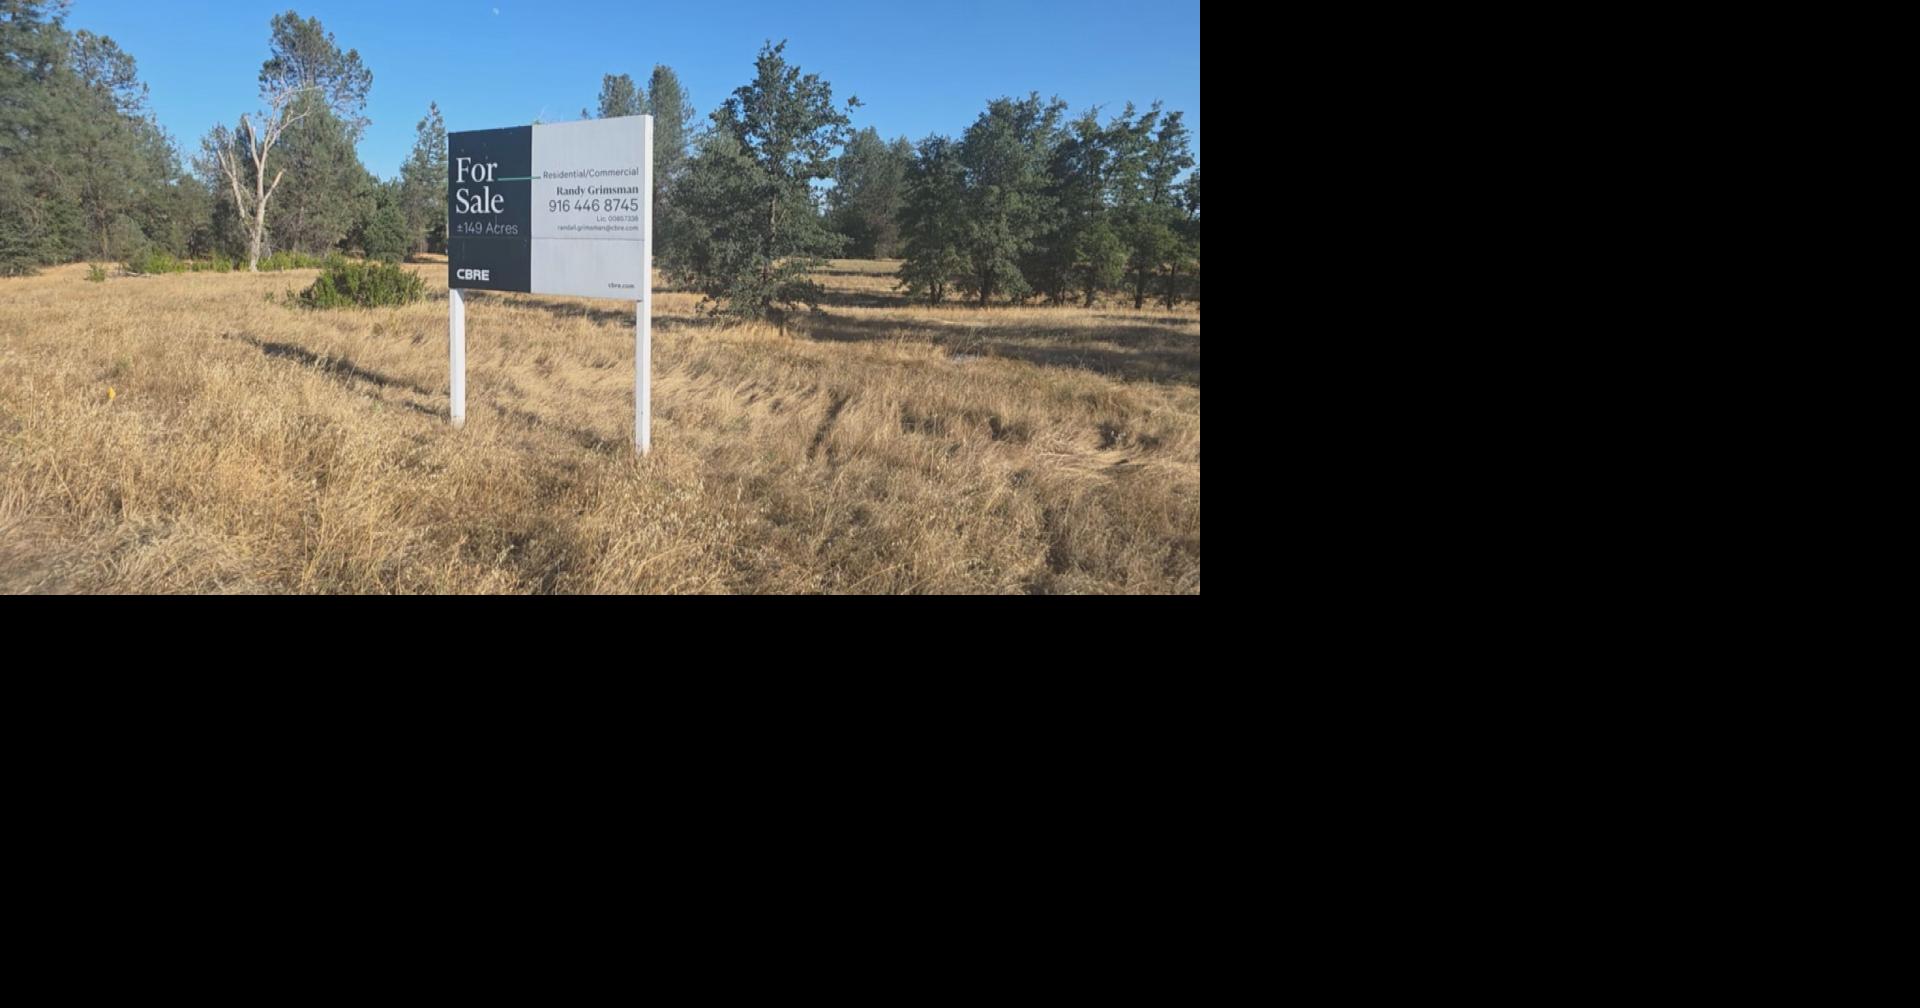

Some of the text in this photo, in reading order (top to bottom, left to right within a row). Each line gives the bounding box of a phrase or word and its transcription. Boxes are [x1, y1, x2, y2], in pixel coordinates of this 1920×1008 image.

[456, 157, 498, 183] For
[543, 167, 639, 179] Residential/Commercial
[556, 185, 639, 197] Randy Grimsman
[456, 186, 504, 214] Sale
[549, 198, 639, 212] 916 446 8745
[485, 222, 519, 235] Acres
[456, 268, 490, 281] CBRE
